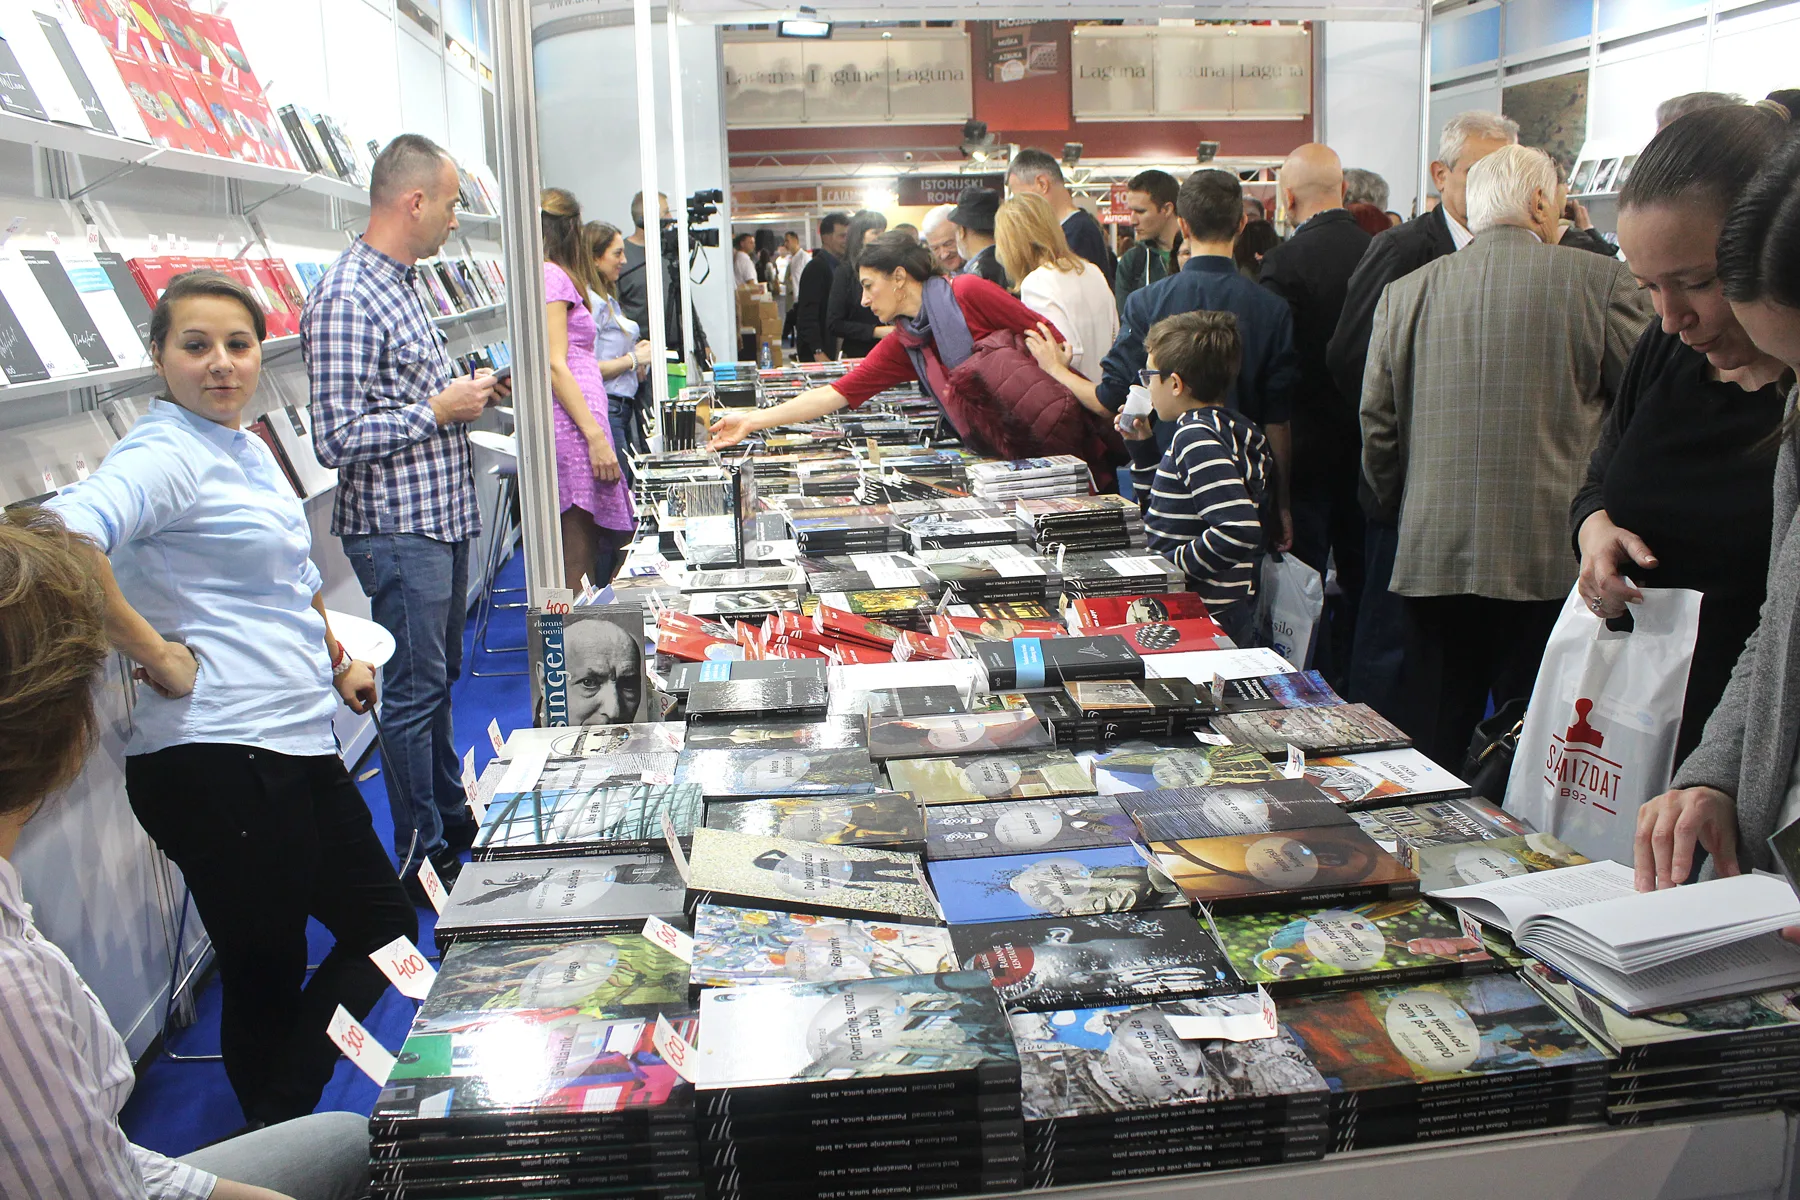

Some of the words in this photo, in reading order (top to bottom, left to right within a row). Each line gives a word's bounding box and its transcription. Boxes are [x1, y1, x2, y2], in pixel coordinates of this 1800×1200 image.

[1079, 63, 1146, 80] Lagna
[1240, 63, 1304, 79] Lagua
[811, 67, 880, 86] Lguna
[896, 67, 965, 85] Laguna
[920, 178, 984, 191] ISTORIJSKI
[546, 599, 570, 615] 400
[1560, 788, 1587, 805] B92
[828, 937, 843, 968] Raskovnik
[398, 953, 425, 979] 400
[843, 991, 856, 1014] sunca,
[1398, 1002, 1419, 1019] kuće
[1415, 1003, 1437, 1018] kući
[868, 1008, 881, 1024] brdu
[1129, 1020, 1143, 1029] da
[1411, 1019, 1428, 1029] od
[872, 1026, 884, 1039] na
[1153, 1024, 1174, 1041] jutro
[1432, 1018, 1470, 1048] povratak
[845, 1014, 864, 1061] Pomračenje
[1136, 1031, 1154, 1049] ovde
[1421, 1029, 1455, 1059] Odlazak
[664, 1035, 685, 1067] 600
[551, 1036, 575, 1076] Svetlarnik
[1164, 1043, 1190, 1077] dočekam
[1148, 1051, 1167, 1073] mogu
[1160, 1075, 1175, 1087] Ne
[867, 1086, 907, 1095] Pomračenje
[912, 1084, 937, 1092] Konrad
[841, 1089, 864, 1098] sunca,
[912, 1111, 936, 1119] Konrad
[1188, 1107, 1205, 1116] mogu
[841, 1116, 864, 1125] sunca,
[867, 1113, 906, 1123] Pomračenje
[1115, 1115, 1130, 1123] jutro
[1131, 1113, 1159, 1122] dočekam
[1170, 1127, 1184, 1135] ovde
[1186, 1123, 1203, 1133] mogu
[1114, 1131, 1129, 1139] jutro
[1130, 1130, 1158, 1138] dočekam
[506, 1138, 539, 1146] Svetlarnik
[870, 1139, 910, 1148] Pomračenje
[915, 1137, 940, 1145] Konrad
[845, 1142, 868, 1151] sunca,
[1185, 1143, 1202, 1152] mogu
[1113, 1151, 1128, 1159] jutro
[1129, 1149, 1156, 1158] dočekam
[873, 1164, 912, 1173] Pomračenje
[917, 1162, 941, 1170] Konrad
[1168, 1163, 1181, 1172] ovde
[1184, 1160, 1201, 1170] mogu
[848, 1167, 870, 1175] sunca,
[1112, 1168, 1127, 1176] jutro
[1128, 1167, 1156, 1175] dočekam
[872, 1186, 911, 1195] Pomračenje
[916, 1184, 940, 1192] Konrad
[847, 1189, 870, 1197] sunca,
